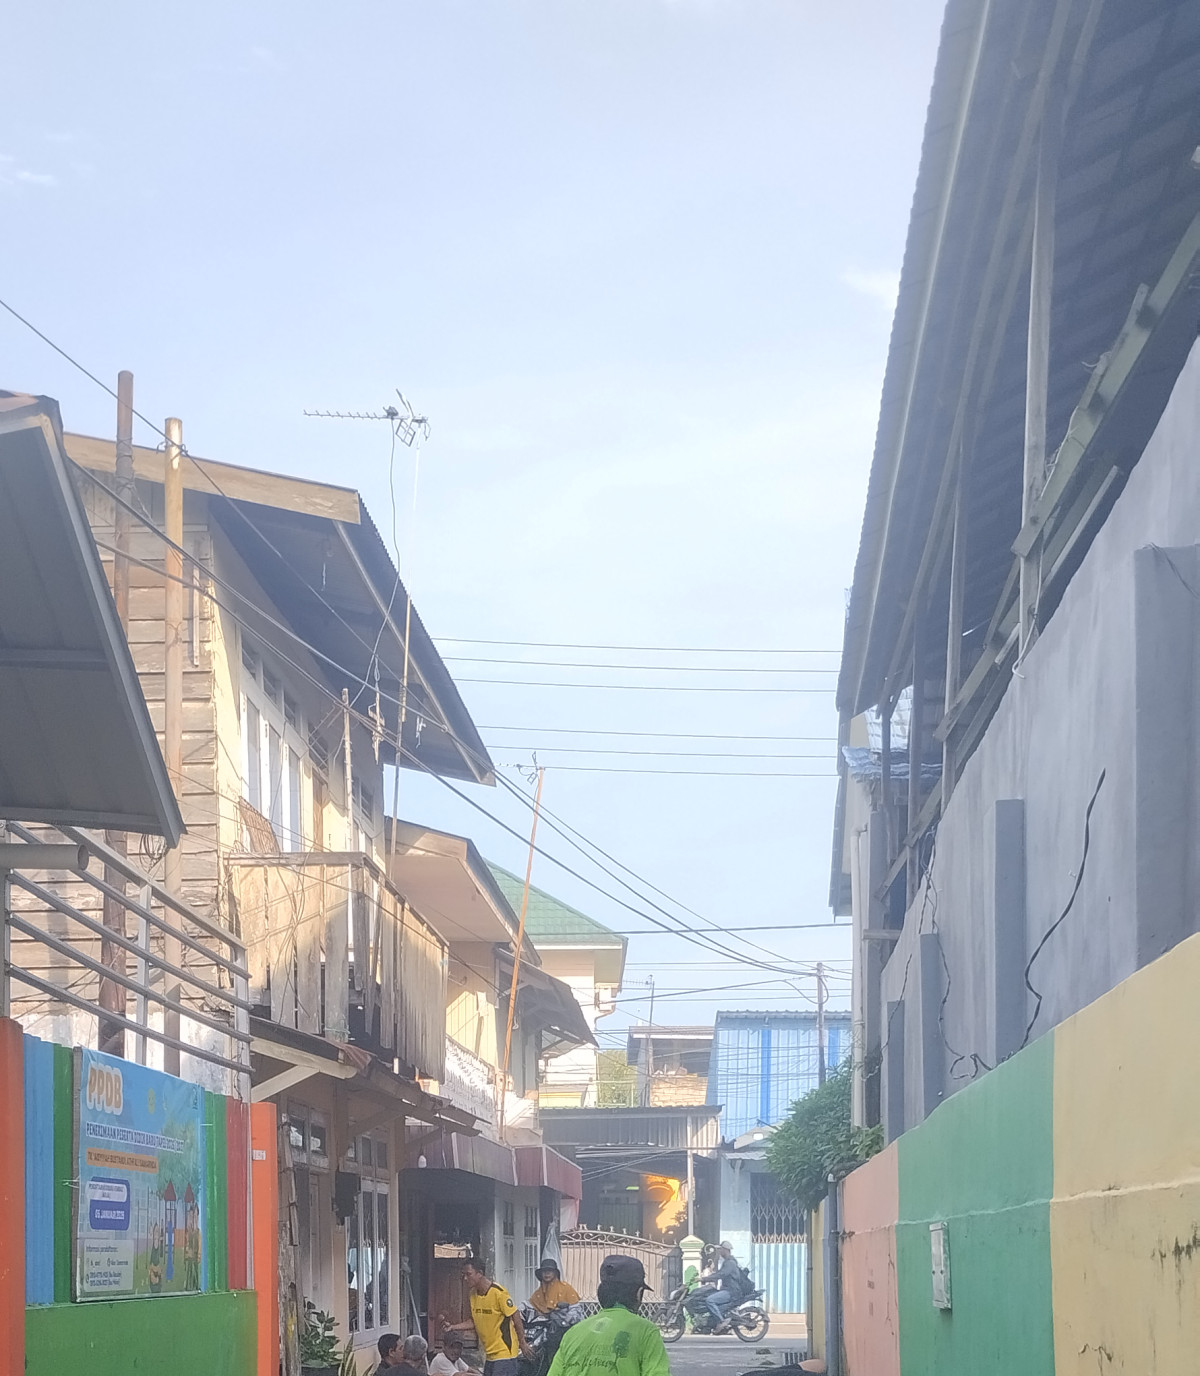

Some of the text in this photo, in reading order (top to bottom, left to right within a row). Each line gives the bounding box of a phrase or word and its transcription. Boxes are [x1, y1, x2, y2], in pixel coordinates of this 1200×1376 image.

[88, 1063, 123, 1114] PPDB
[86, 1121, 117, 1139] PENERIMAAN
[117, 1127, 134, 1142] PESERTA
